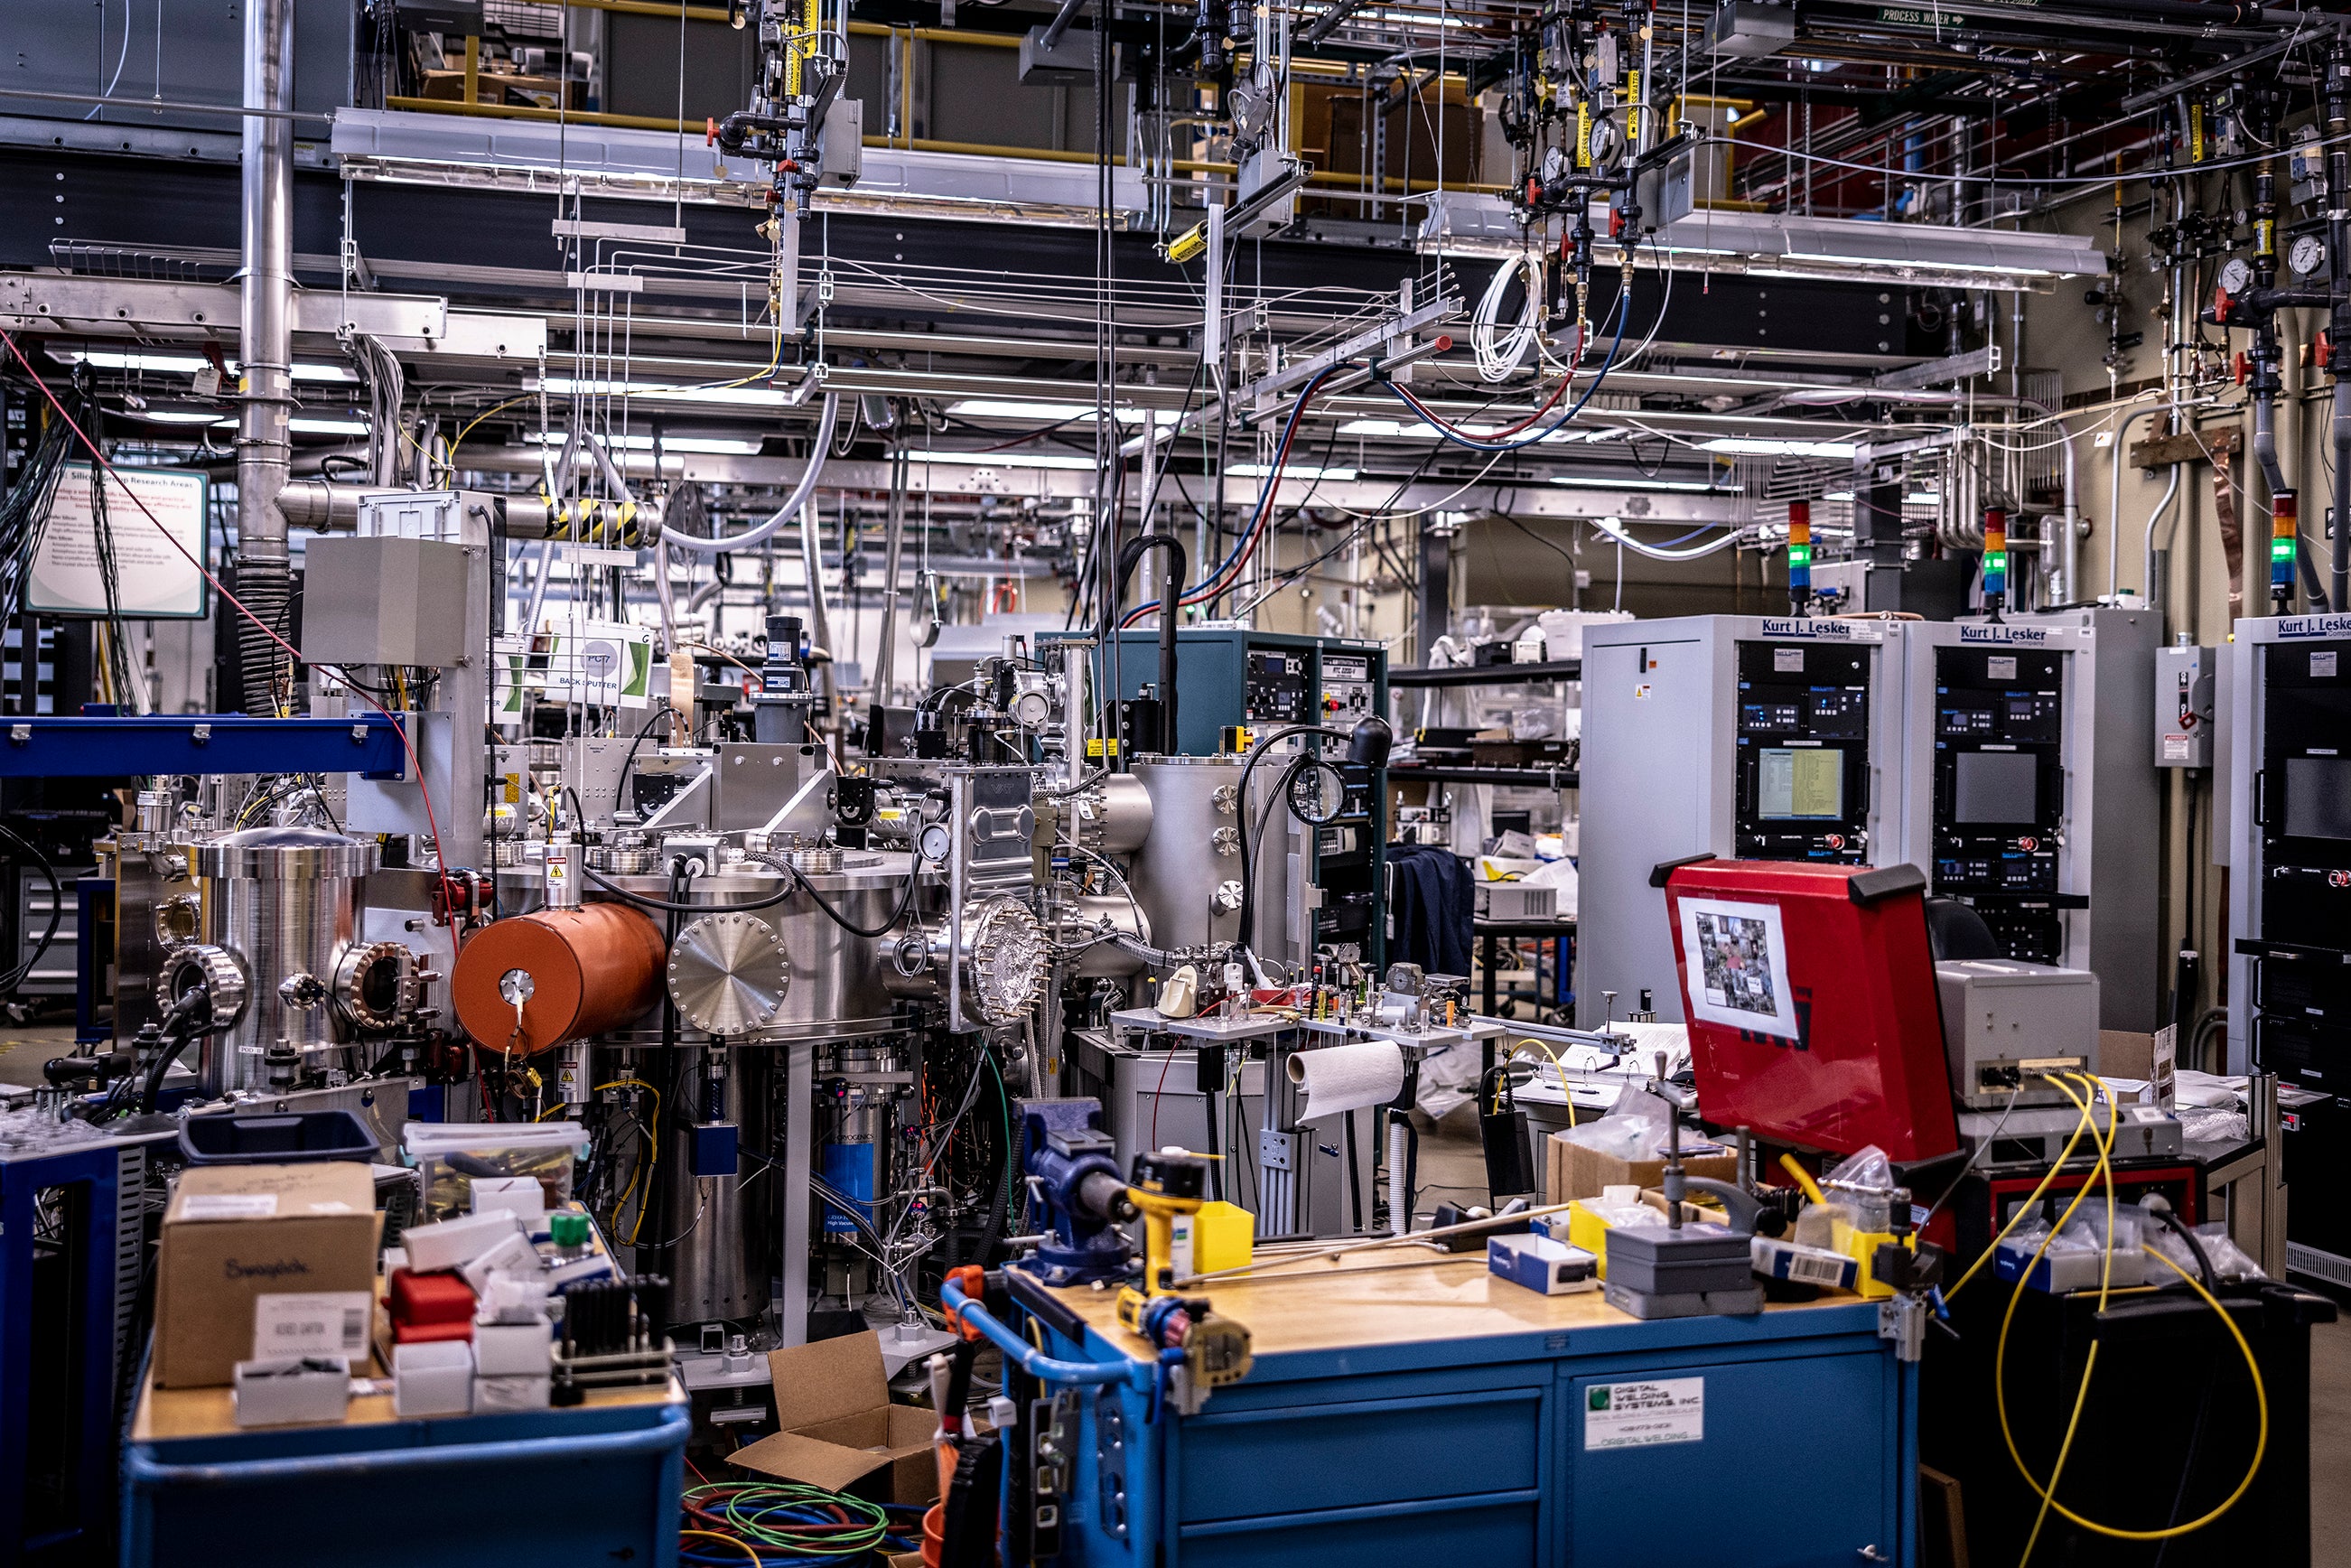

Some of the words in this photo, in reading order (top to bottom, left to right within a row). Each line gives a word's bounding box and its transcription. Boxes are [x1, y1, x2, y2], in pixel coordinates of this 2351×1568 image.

[1882, 9, 1919, 23] PROCESS
[786, 63, 794, 93] PROCESS
[1581, 139, 1589, 165] PROCESS
[131, 477, 168, 486] Research
[170, 480, 193, 489] Areas
[1762, 620, 1791, 632] Kurt
[1795, 621, 1804, 634] J.
[1808, 621, 1850, 634] Lesker
[1961, 626, 1988, 638] Kurt
[1992, 627, 2000, 640] J.
[2005, 627, 2046, 640] Lesker
[2278, 620, 2303, 632] Kurt
[2307, 619, 2315, 633] J.
[642, 634, 649, 643] G
[559, 677, 581, 686] BACK
[583, 679, 618, 690] PUTTER
[991, 784, 1014, 795] VAT
[1614, 1385, 1658, 1394] DIGITAL
[1614, 1391, 1669, 1402] WELDING
[1600, 1436, 1644, 1446] ORBITAL
[1645, 1432, 1688, 1442] WELDING
